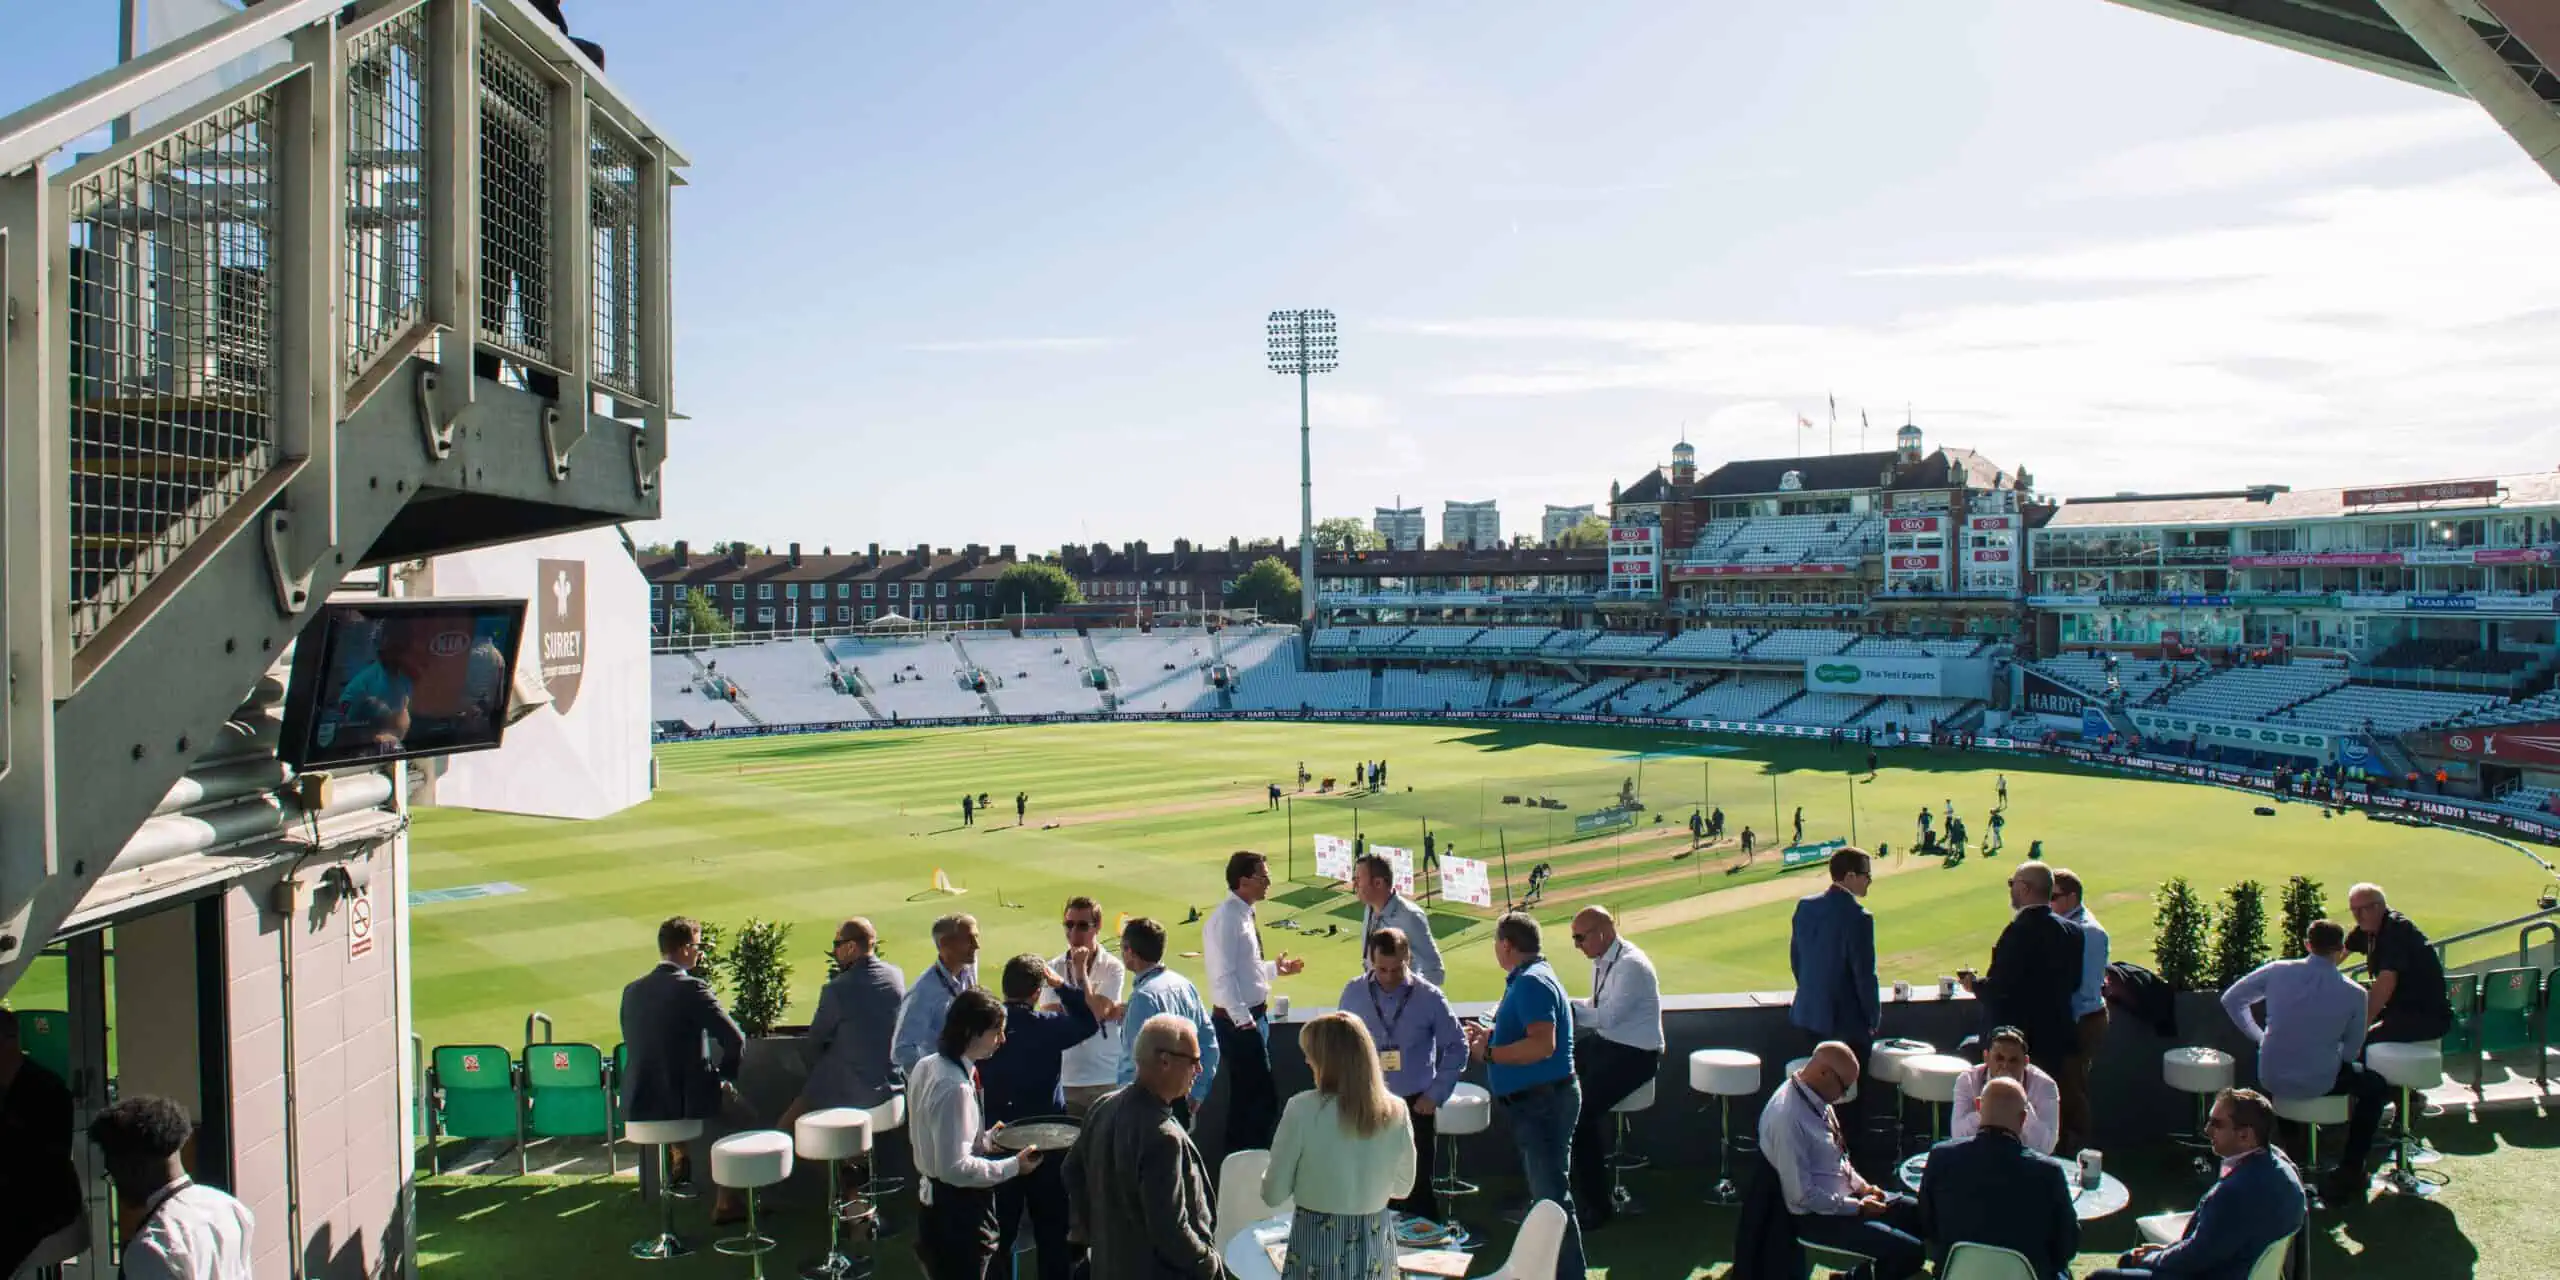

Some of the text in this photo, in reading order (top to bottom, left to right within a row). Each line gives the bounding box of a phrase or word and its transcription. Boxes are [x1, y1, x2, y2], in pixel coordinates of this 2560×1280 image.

[544, 631, 580, 660] SURREY
[2029, 692, 2082, 714] HARDYS
[2423, 801, 2465, 819] HARDYS
